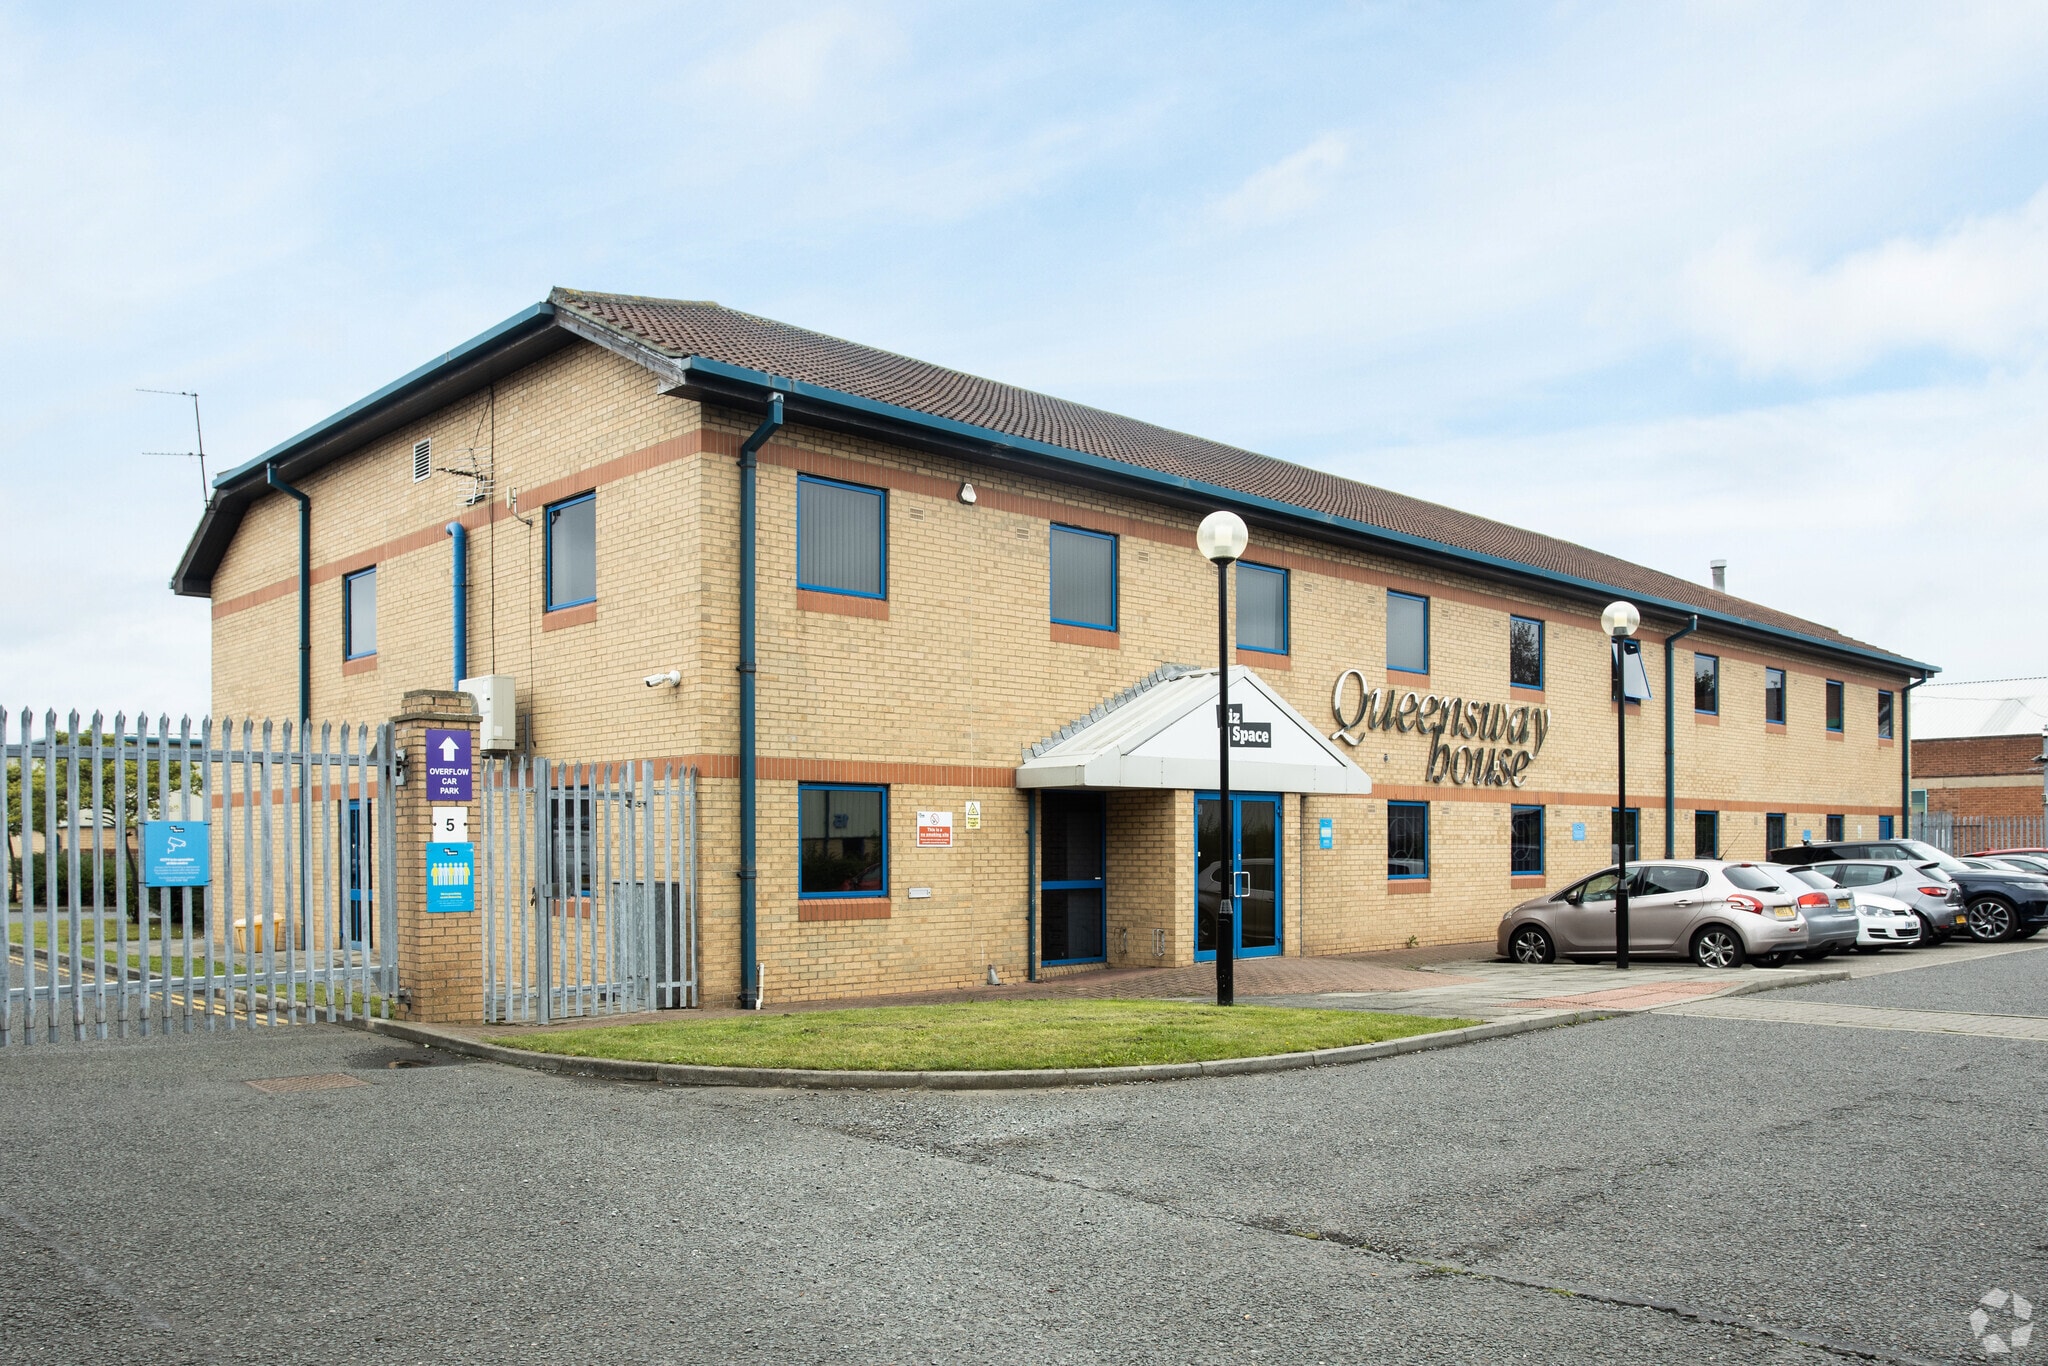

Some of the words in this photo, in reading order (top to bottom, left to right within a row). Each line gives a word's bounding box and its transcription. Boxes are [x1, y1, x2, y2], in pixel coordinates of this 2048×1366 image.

[1330, 669, 1551, 760] Queensway
[1232, 725, 1270, 744] Space
[1425, 725, 1528, 787] house
[429, 767, 469, 776] OVERFLOW
[441, 777, 457, 785] CAR
[440, 787, 459, 795] PARK
[446, 818, 455, 832] 5
